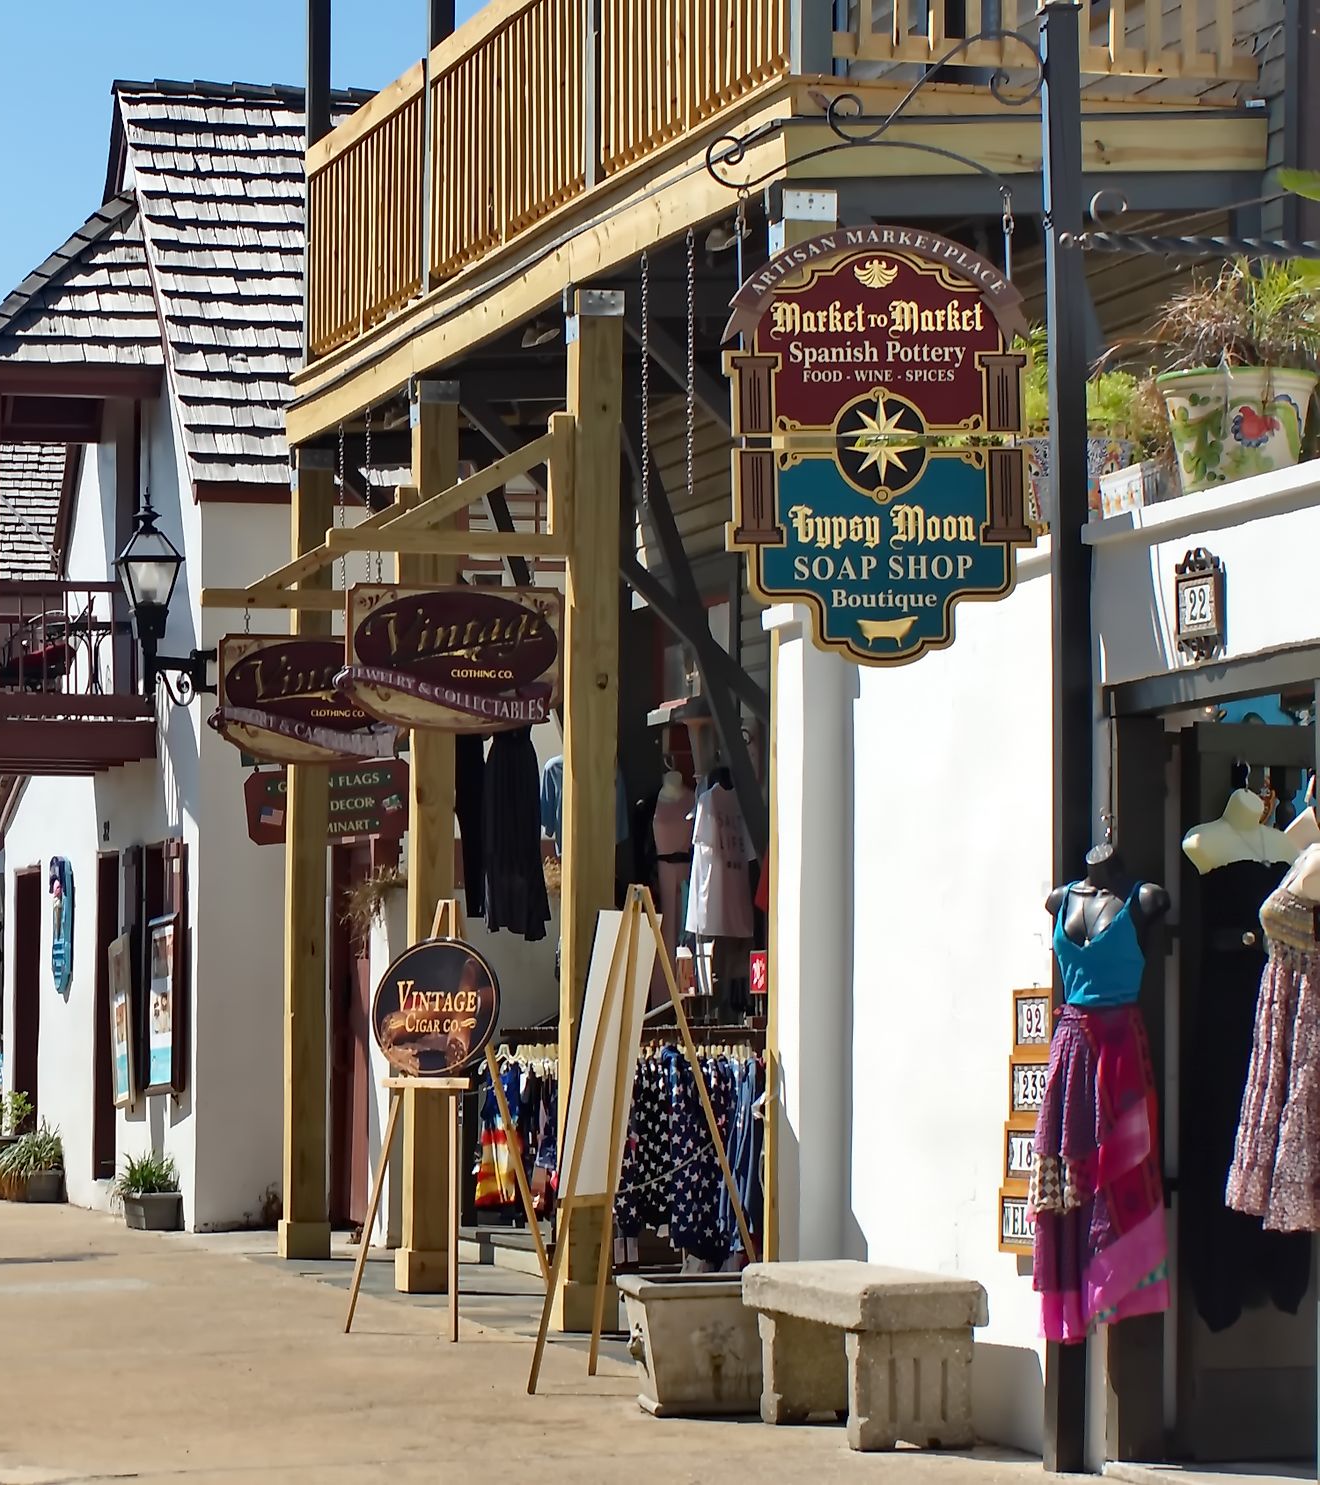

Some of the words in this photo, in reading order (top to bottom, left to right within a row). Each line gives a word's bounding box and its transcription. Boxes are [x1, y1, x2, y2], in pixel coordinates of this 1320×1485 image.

[751, 236, 836, 296] ARTISAN
[846, 229, 1007, 295] MARKETPLACE
[769, 299, 866, 340] Market
[888, 299, 985, 339] Market
[789, 341, 879, 368] Spanish
[886, 341, 966, 368] Pottery
[802, 369, 843, 383] FOOD
[854, 369, 893, 382] WINE
[905, 369, 955, 382] SPICES
[787, 504, 880, 549] Gypsy
[889, 503, 977, 550] Moon
[793, 555, 878, 581] SOAP
[887, 554, 974, 580] SHOP
[830, 588, 938, 612] Boutique
[1188, 589, 1207, 621] 22
[450, 668, 496, 679] CLOTHING
[498, 669, 514, 679] CO.
[351, 666, 415, 690] JEWELRY
[418, 681, 430, 695] &
[434, 686, 545, 721] COLLECTABLES
[310, 709, 351, 718] CLOTHING
[338, 772, 380, 787] FLAGS
[330, 797, 374, 812] DECOR
[397, 980, 477, 1013] VINTAGE
[405, 1012, 441, 1033] CIGAR
[442, 1018, 462, 1033] CO.
[1026, 1008, 1042, 1034] 92
[1022, 1073, 1046, 1100] 239
